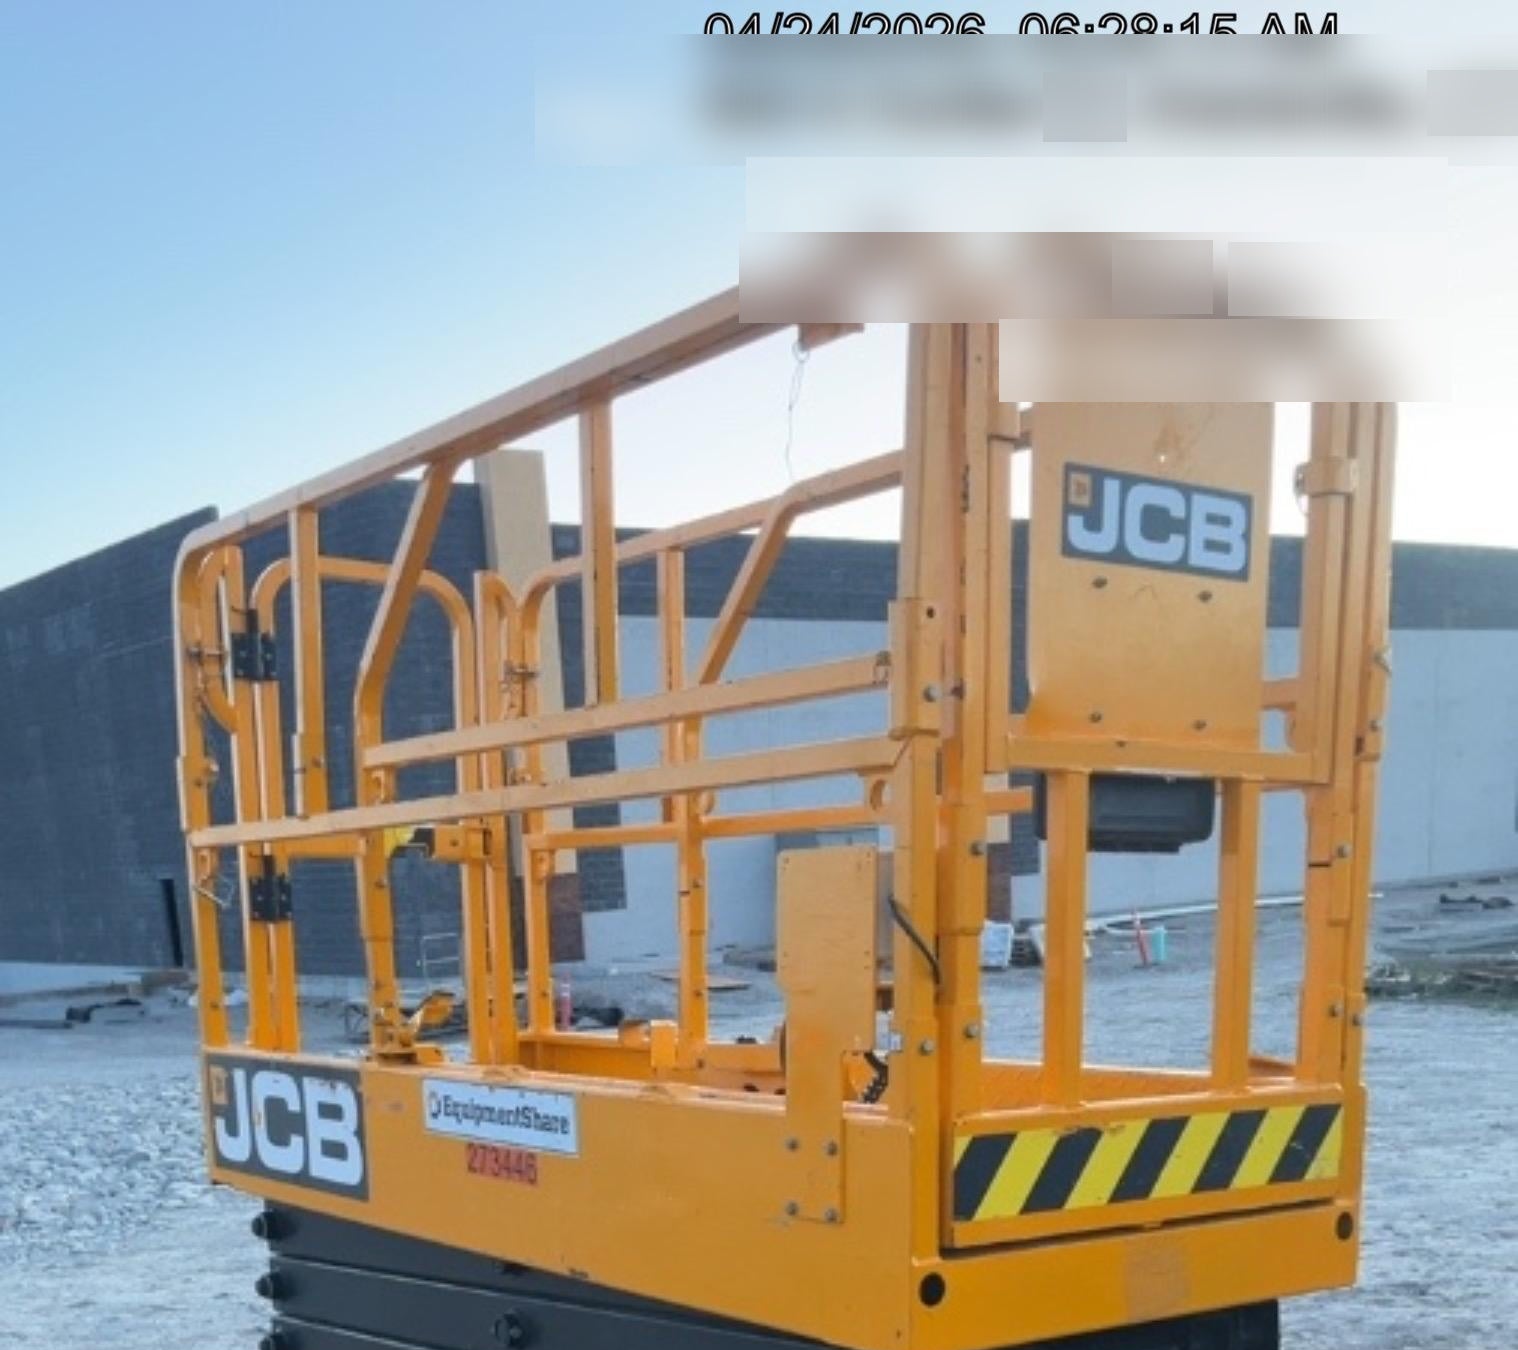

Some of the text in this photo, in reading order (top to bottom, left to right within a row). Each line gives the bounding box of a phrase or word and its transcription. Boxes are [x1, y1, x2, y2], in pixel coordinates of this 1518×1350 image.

[1067, 477, 1247, 572] JCB
[214, 1068, 364, 1186] JCB
[442, 1094, 570, 1135] EquipmentShare
